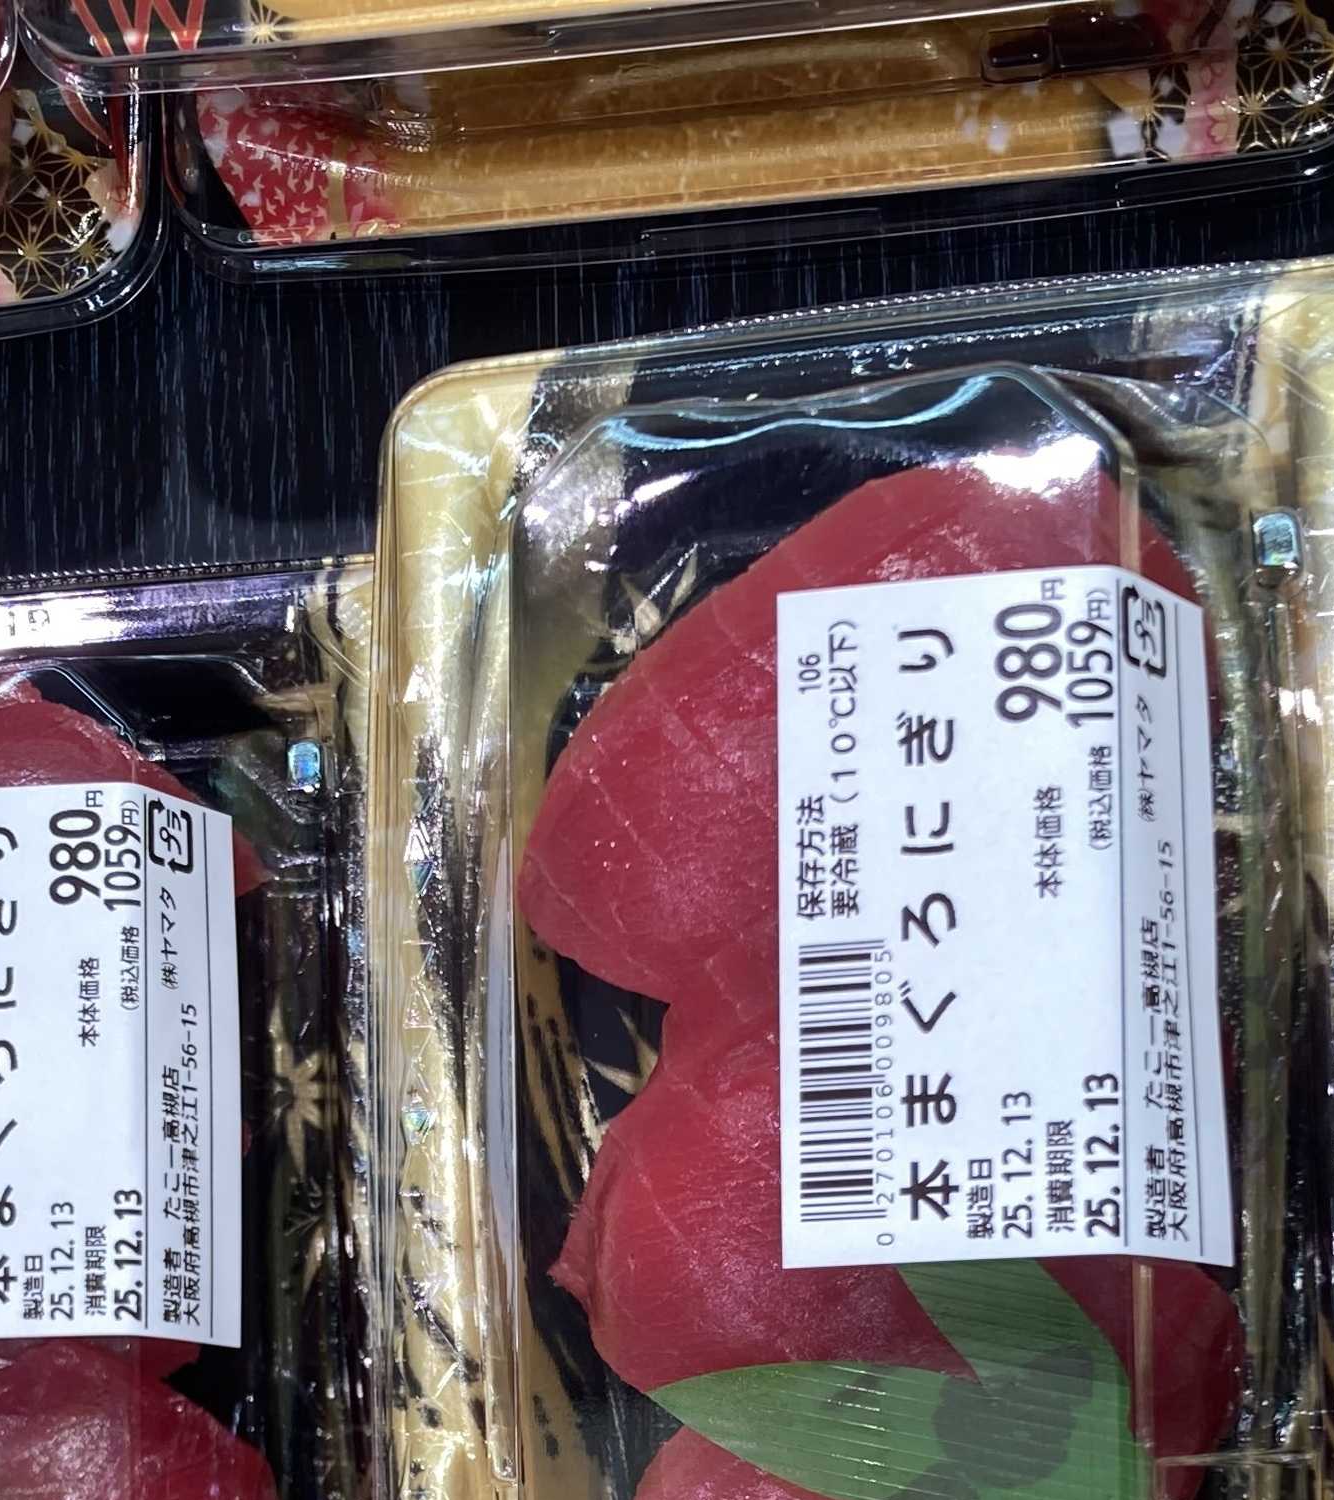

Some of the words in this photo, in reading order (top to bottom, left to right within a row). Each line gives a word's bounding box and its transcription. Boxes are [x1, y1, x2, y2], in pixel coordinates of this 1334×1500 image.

[798, 654, 820, 694] 106
[797, 795, 826, 920] 保存方法
[1035, 786, 1063, 899] 本体価格
[898, 627, 959, 1221] 本まぐろにぎり
[78, 957, 100, 1047] 本体価格
[968, 1158, 993, 1239] 製造日
[1002, 1091, 1034, 1239] 25.12.13
[1047, 1120, 1075, 1233] 消費期限
[1084, 1073, 1121, 1237] 25.12.13
[24, 1254, 43, 1320] 製造日
[50, 1202, 74, 1320] 25.12.13
[85, 1226, 106, 1316] 消費期限
[114, 1189, 143, 1320] 25.12.13
[162, 1248, 180, 1324] 製造者
